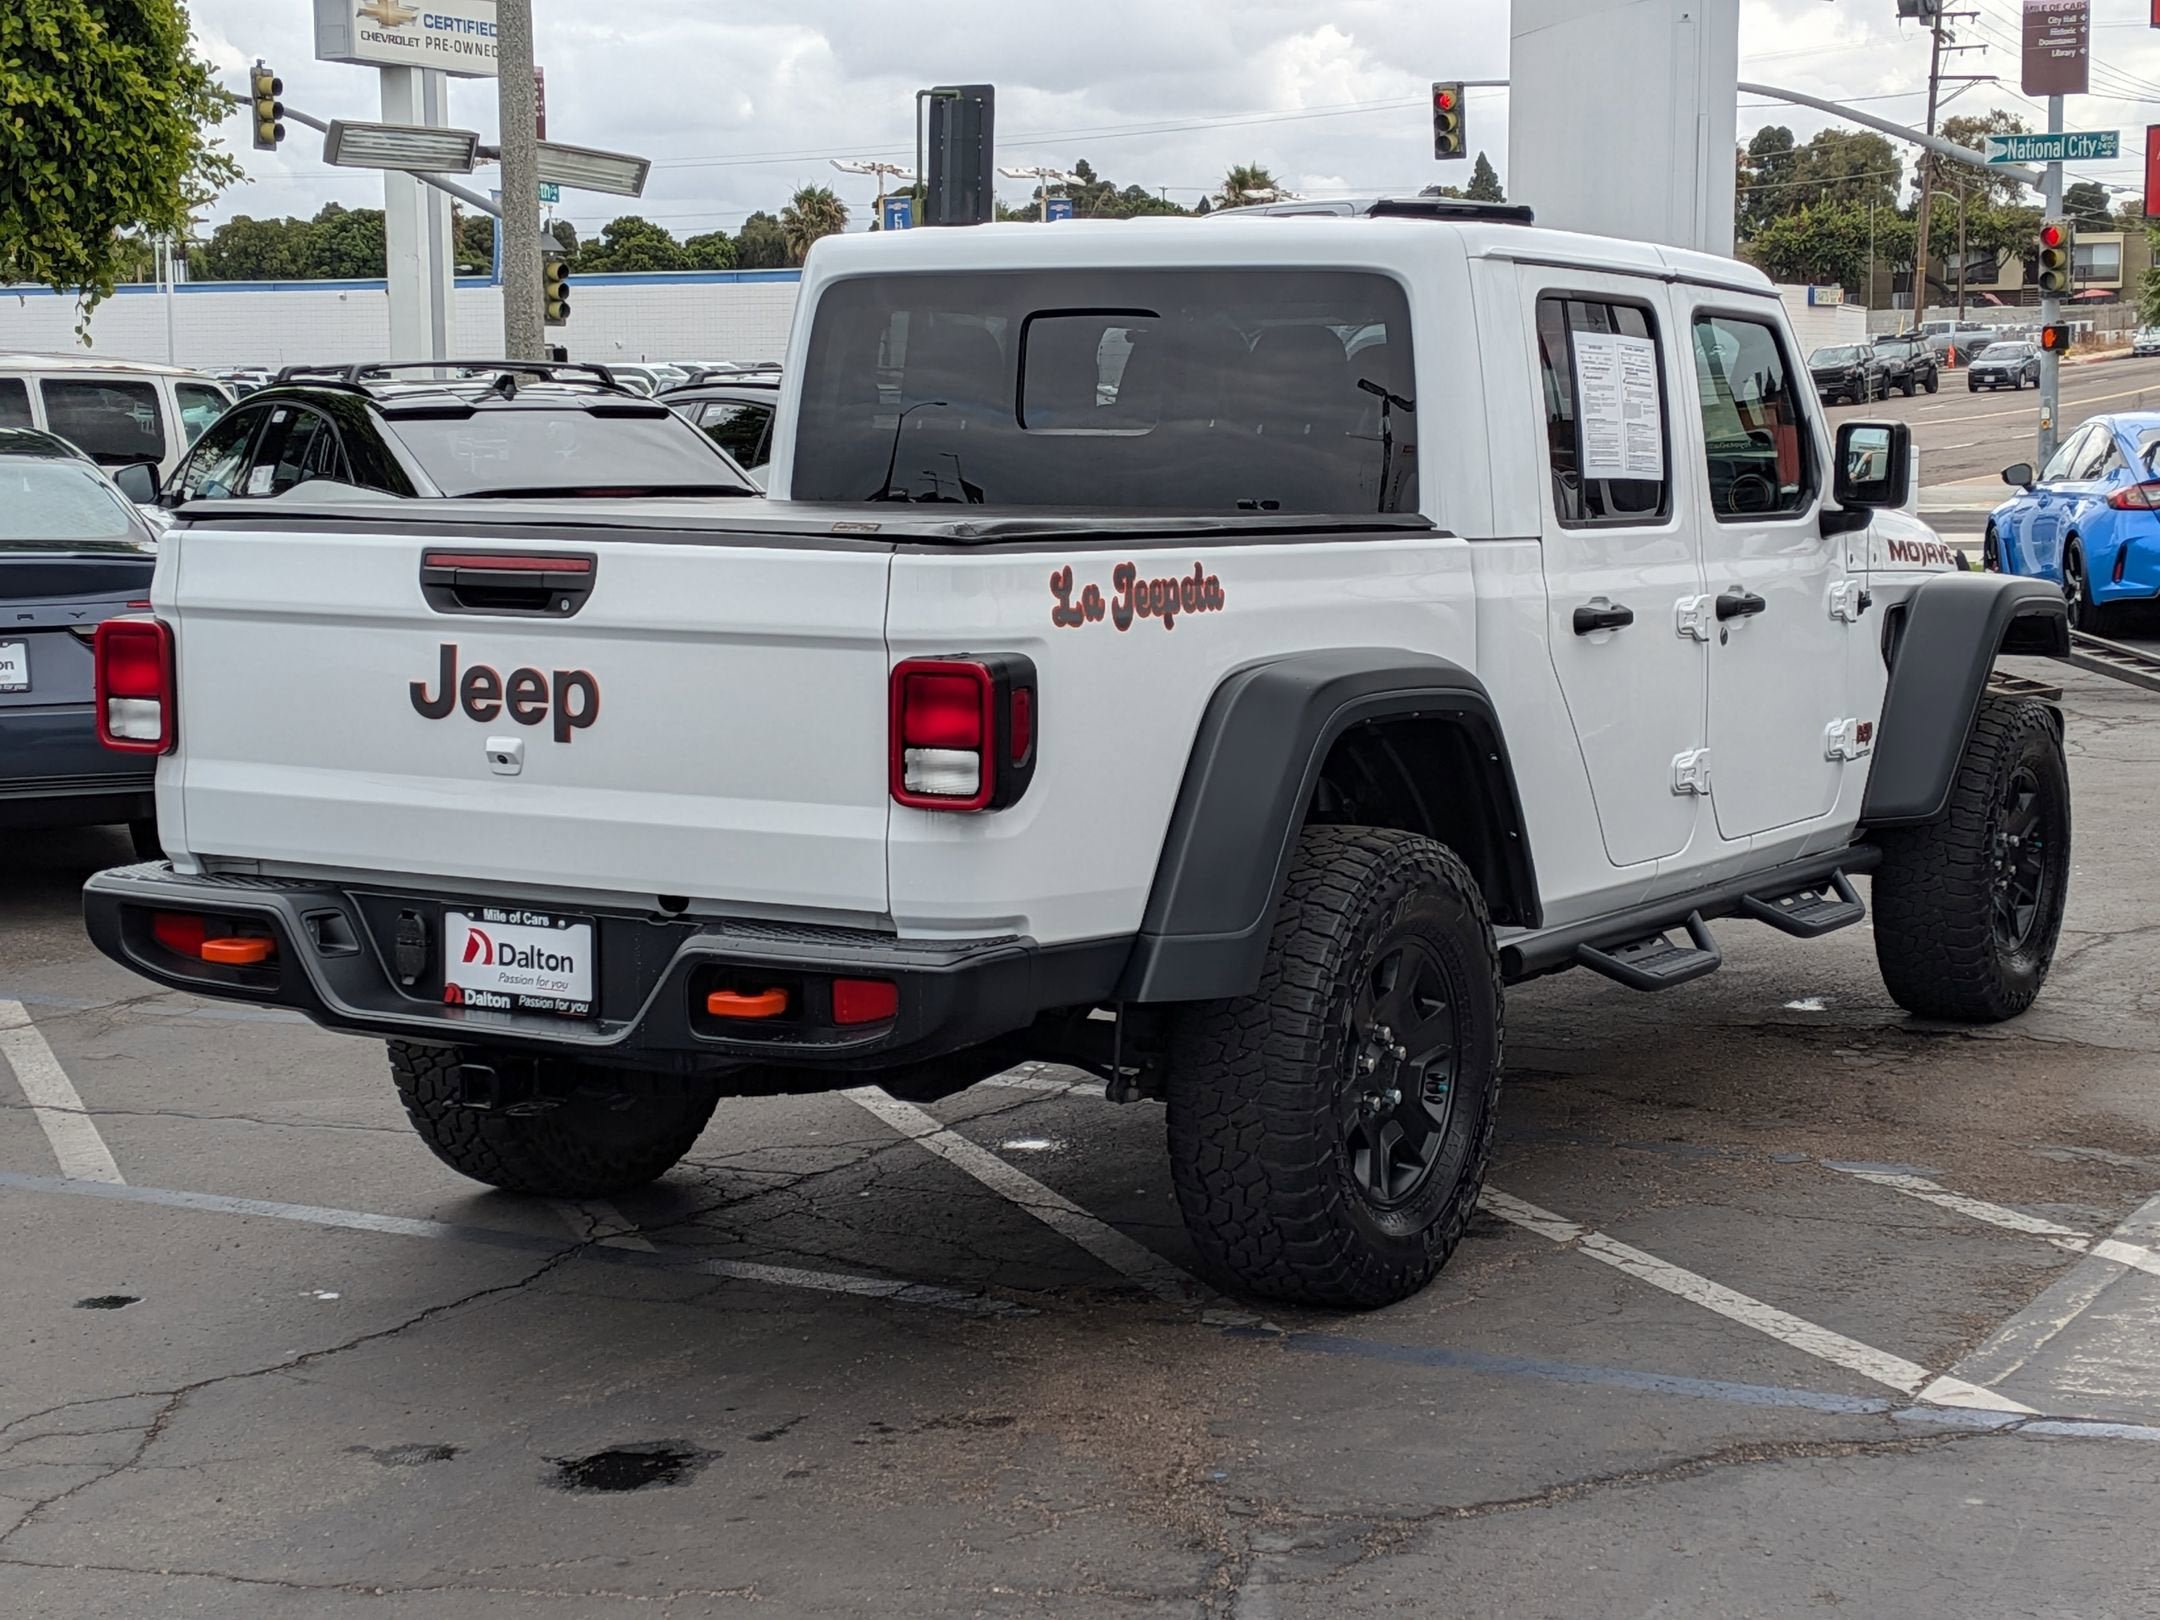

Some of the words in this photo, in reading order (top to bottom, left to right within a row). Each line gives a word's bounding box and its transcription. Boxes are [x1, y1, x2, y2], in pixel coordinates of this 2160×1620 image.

[2048, 16, 2062, 25] City
[360, 30, 420, 48] CHEVROLET
[425, 36, 499, 58] PRE-OWNED
[2052, 49, 2076, 57] Library
[2007, 137, 2065, 160] National
[2069, 135, 2098, 158] City
[1887, 538, 1955, 567] MOJAVE
[1050, 565, 1106, 628] La
[1111, 561, 1225, 632] Jeepeta
[410, 644, 600, 743] Jeep
[483, 908, 507, 922] Mile
[509, 911, 521, 924] of
[523, 913, 550, 926] Cars
[498, 943, 574, 973] Dalton
[498, 972, 534, 986] Passion
[536, 976, 548, 987] for
[550, 980, 569, 990] you
[464, 990, 511, 1009] Dalton
[518, 995, 553, 1009] Passion
[554, 999, 569, 1010] for
[570, 1003, 589, 1013] you
